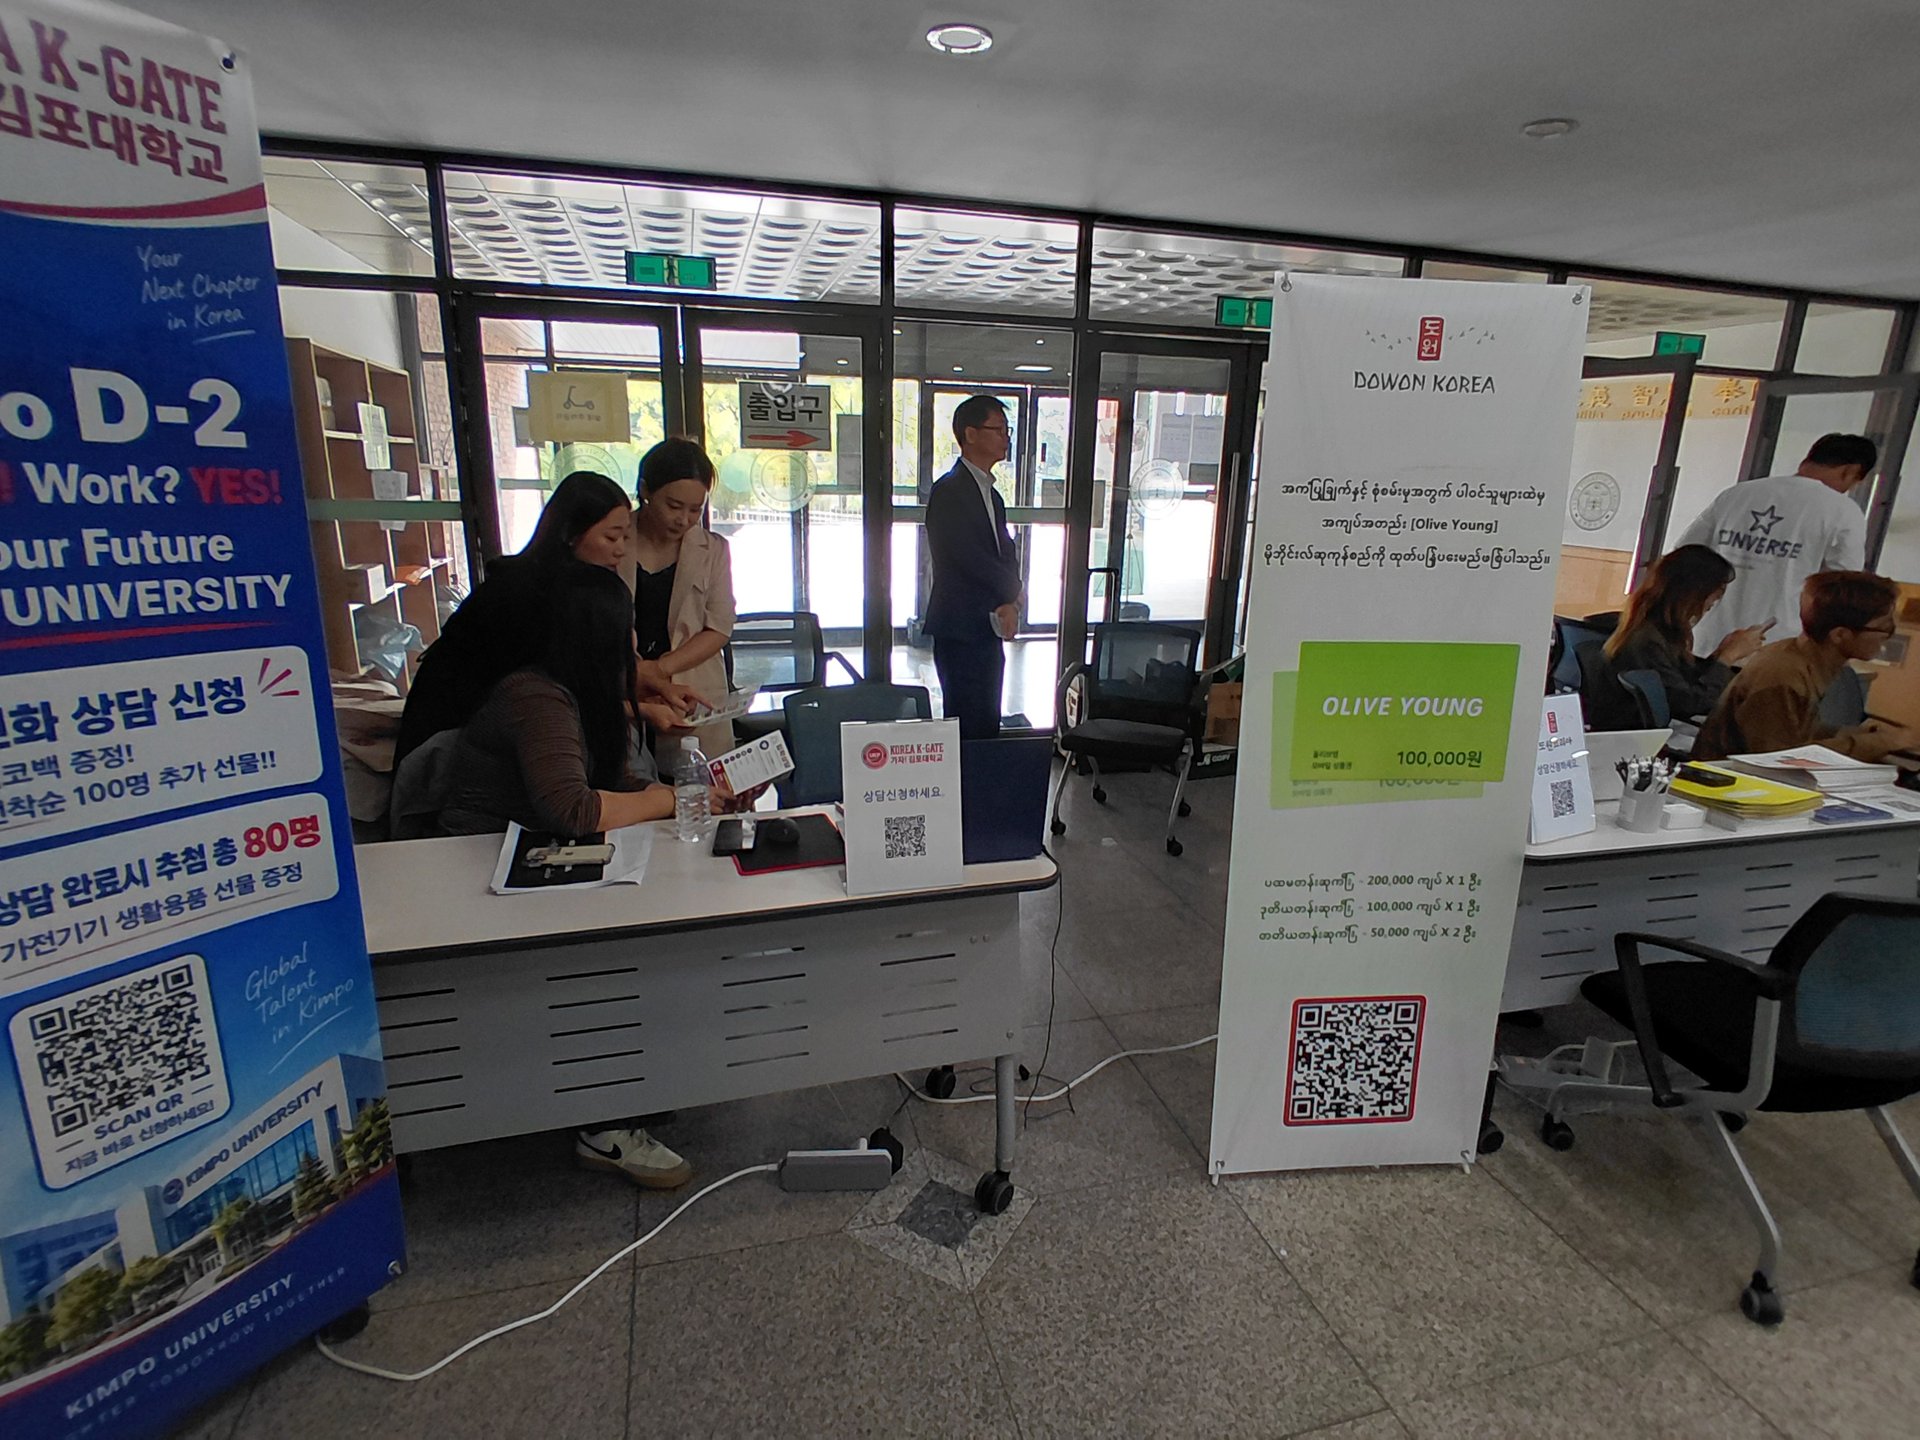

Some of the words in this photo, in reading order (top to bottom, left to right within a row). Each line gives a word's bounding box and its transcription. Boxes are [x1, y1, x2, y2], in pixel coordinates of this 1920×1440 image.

[29, 18, 228, 135] K-GATE
[136, 244, 182, 272] Your
[142, 275, 185, 303] Next
[192, 273, 260, 300] Chapter
[168, 311, 187, 330] in
[194, 303, 245, 328] Korea
[1421, 319, 1441, 358] 도원
[1354, 371, 1426, 391] DOWON
[1433, 374, 1495, 394] KOREA
[70, 366, 248, 449] D-2
[746, 391, 823, 423] 출입구
[22, 462, 181, 505] Work?
[188, 467, 284, 506] YES!
[1410, 517, 1448, 531] [Olive
[1452, 519, 1498, 534] Young]
[81, 528, 235, 567] Future
[2, 573, 293, 627] UNIVERSITY
[0, 701, 59, 749] 화
[71, 687, 157, 736] 상담
[169, 676, 247, 722] 신청
[1322, 696, 1392, 717] OLIVE
[1400, 696, 1484, 718] YOUNG
[70, 744, 135, 775] 증정!
[890, 744, 915, 755] KOREA
[917, 743, 944, 754] K-GATE
[1396, 750, 1482, 768] 100,000원
[73, 771, 151, 806] 100명
[159, 761, 207, 790] 추가
[213, 750, 277, 779] 선물!!
[62, 858, 150, 909] 완료시
[155, 843, 208, 881] 추첨
[212, 836, 238, 867] 총
[243, 814, 322, 858] 80명
[1367, 874, 1414, 887] 200,000
[0, 915, 108, 963] 가전기기
[115, 886, 208, 930] 생활용품
[213, 874, 256, 901] 선물
[261, 862, 303, 888] 증정
[1367, 901, 1413, 912] 100,000
[1371, 927, 1409, 938] 50,000
[245, 940, 308, 1001] Global
[255, 968, 317, 1024] Talent
[273, 1025, 290, 1044] in
[299, 978, 354, 1026] Kimpo
[65, 1150, 98, 1173] 지금
[102, 1134, 135, 1156] 바로
[139, 1099, 215, 1142] 신청하세요!
[94, 1106, 151, 1139] SCAN
[155, 1093, 184, 1113] QR
[185, 1148, 230, 1187] KIMPO
[232, 1080, 324, 1153] UNIVERSITY
[66, 1356, 156, 1420] KIMPO
[165, 1273, 294, 1360] UNIVERSITY
